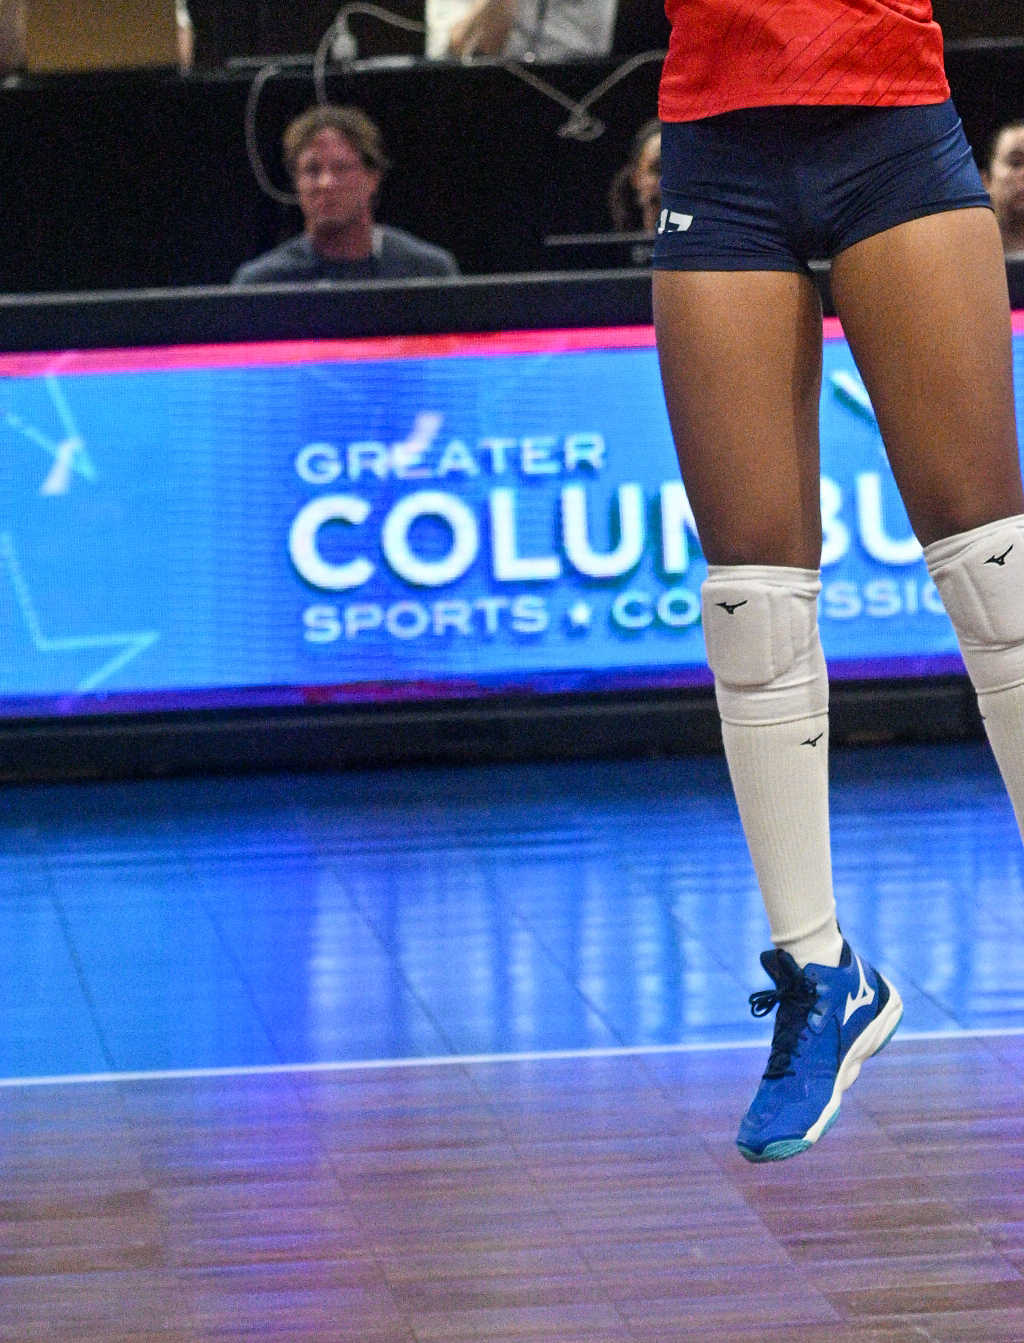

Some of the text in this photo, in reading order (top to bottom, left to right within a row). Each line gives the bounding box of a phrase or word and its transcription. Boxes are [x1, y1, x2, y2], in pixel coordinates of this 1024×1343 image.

[296, 432, 607, 484] GREATER
[289, 471, 925, 591] COLUU
[303, 595, 550, 642] SPORTS
